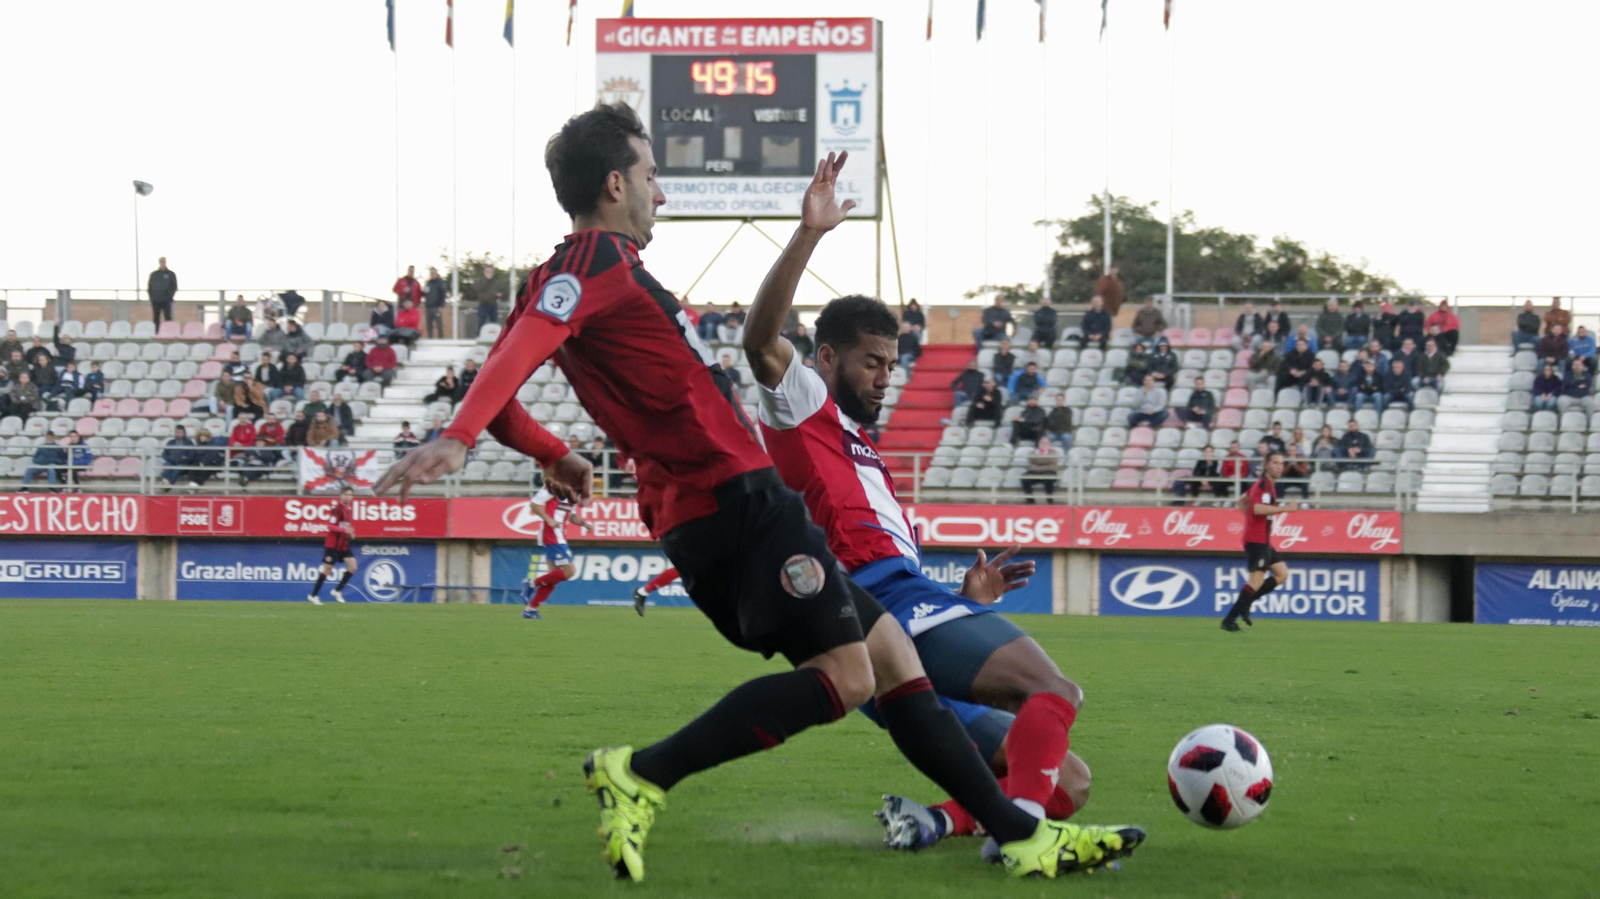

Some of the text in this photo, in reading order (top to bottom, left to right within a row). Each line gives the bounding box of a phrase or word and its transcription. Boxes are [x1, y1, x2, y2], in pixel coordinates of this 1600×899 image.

[617, 26, 717, 47] GIGANTE
[740, 20, 866, 47] EMPEÑOS
[661, 108, 713, 122] LOCAL
[659, 182, 738, 194] ERMOTOR
[743, 182, 809, 194] ALGECIR
[666, 200, 782, 211] SERVICIO OFICIAL
[0, 496, 138, 532] ESTRECHO
[180, 514, 209, 525] PSOE
[284, 499, 417, 521] Soclistas
[284, 522, 330, 534] de Algec
[1081, 510, 1132, 546] Okay
[1162, 511, 1215, 547] Okay
[1270, 512, 1309, 549] kay
[1346, 514, 1400, 550] Okay
[0, 564, 122, 579] OGRUAS
[181, 561, 283, 581] Grazalema
[1214, 592, 1366, 615] PRMOTOR
